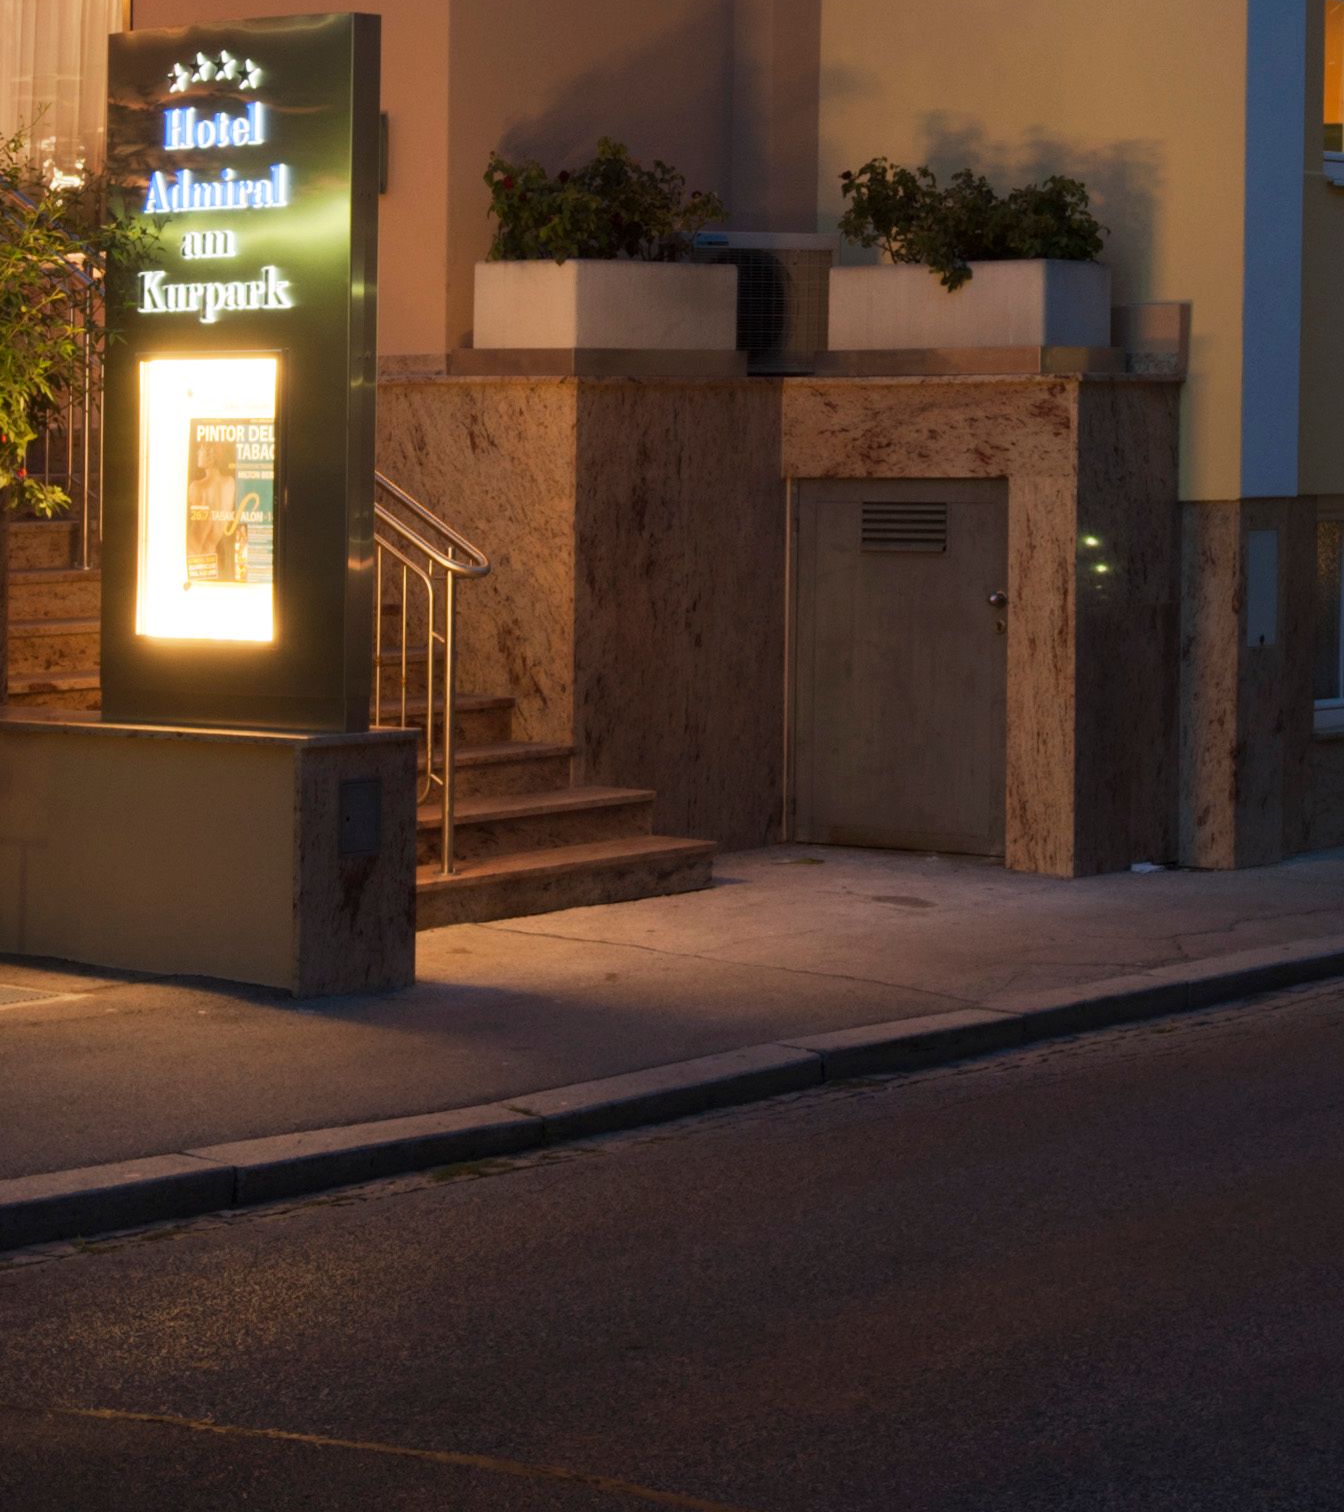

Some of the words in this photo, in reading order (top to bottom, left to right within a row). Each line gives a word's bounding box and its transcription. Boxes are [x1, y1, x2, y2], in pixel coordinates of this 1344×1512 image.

[163, 101, 265, 151] Hotel
[144, 163, 289, 214] Admiral
[181, 229, 236, 260] am
[137, 265, 293, 324] Kurpark
[196, 424, 245, 442] PINTOR
[248, 424, 275, 442] DEL
